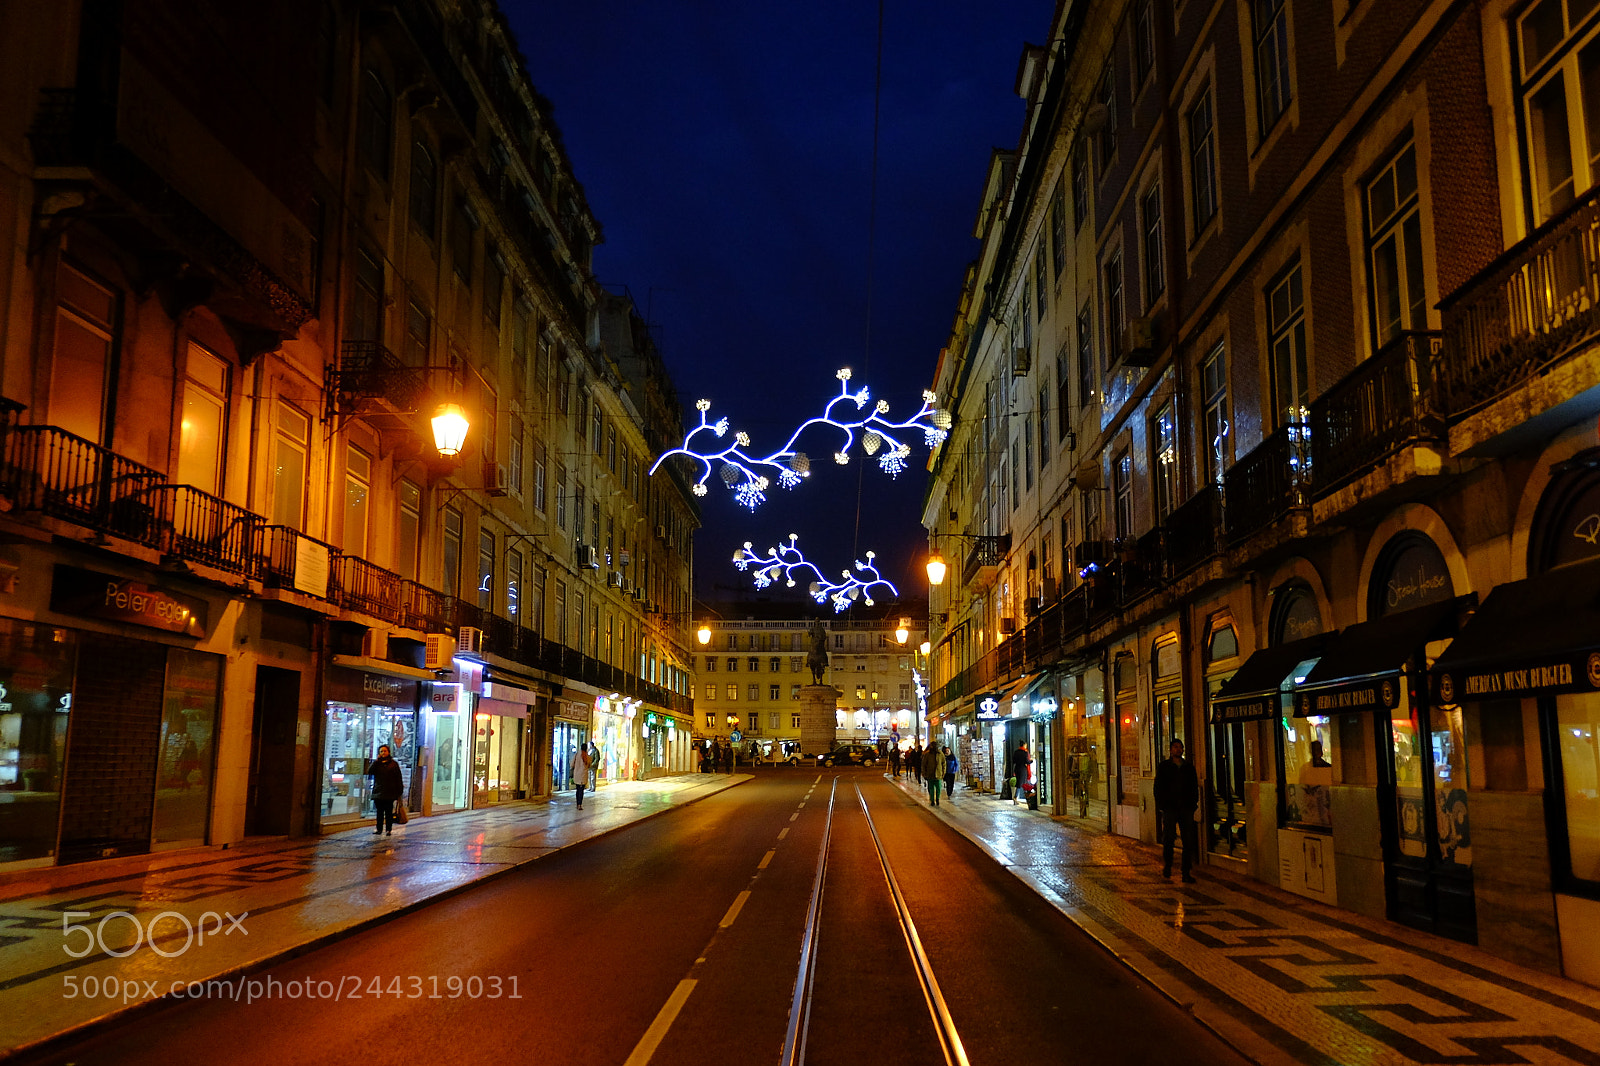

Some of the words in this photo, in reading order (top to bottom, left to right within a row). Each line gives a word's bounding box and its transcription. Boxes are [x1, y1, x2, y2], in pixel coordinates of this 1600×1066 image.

[1465, 673, 1502, 695] AMERICAN
[1504, 669, 1530, 691] MUSIC
[1530, 663, 1573, 688] BURGUER
[433, 693, 455, 702] ara
